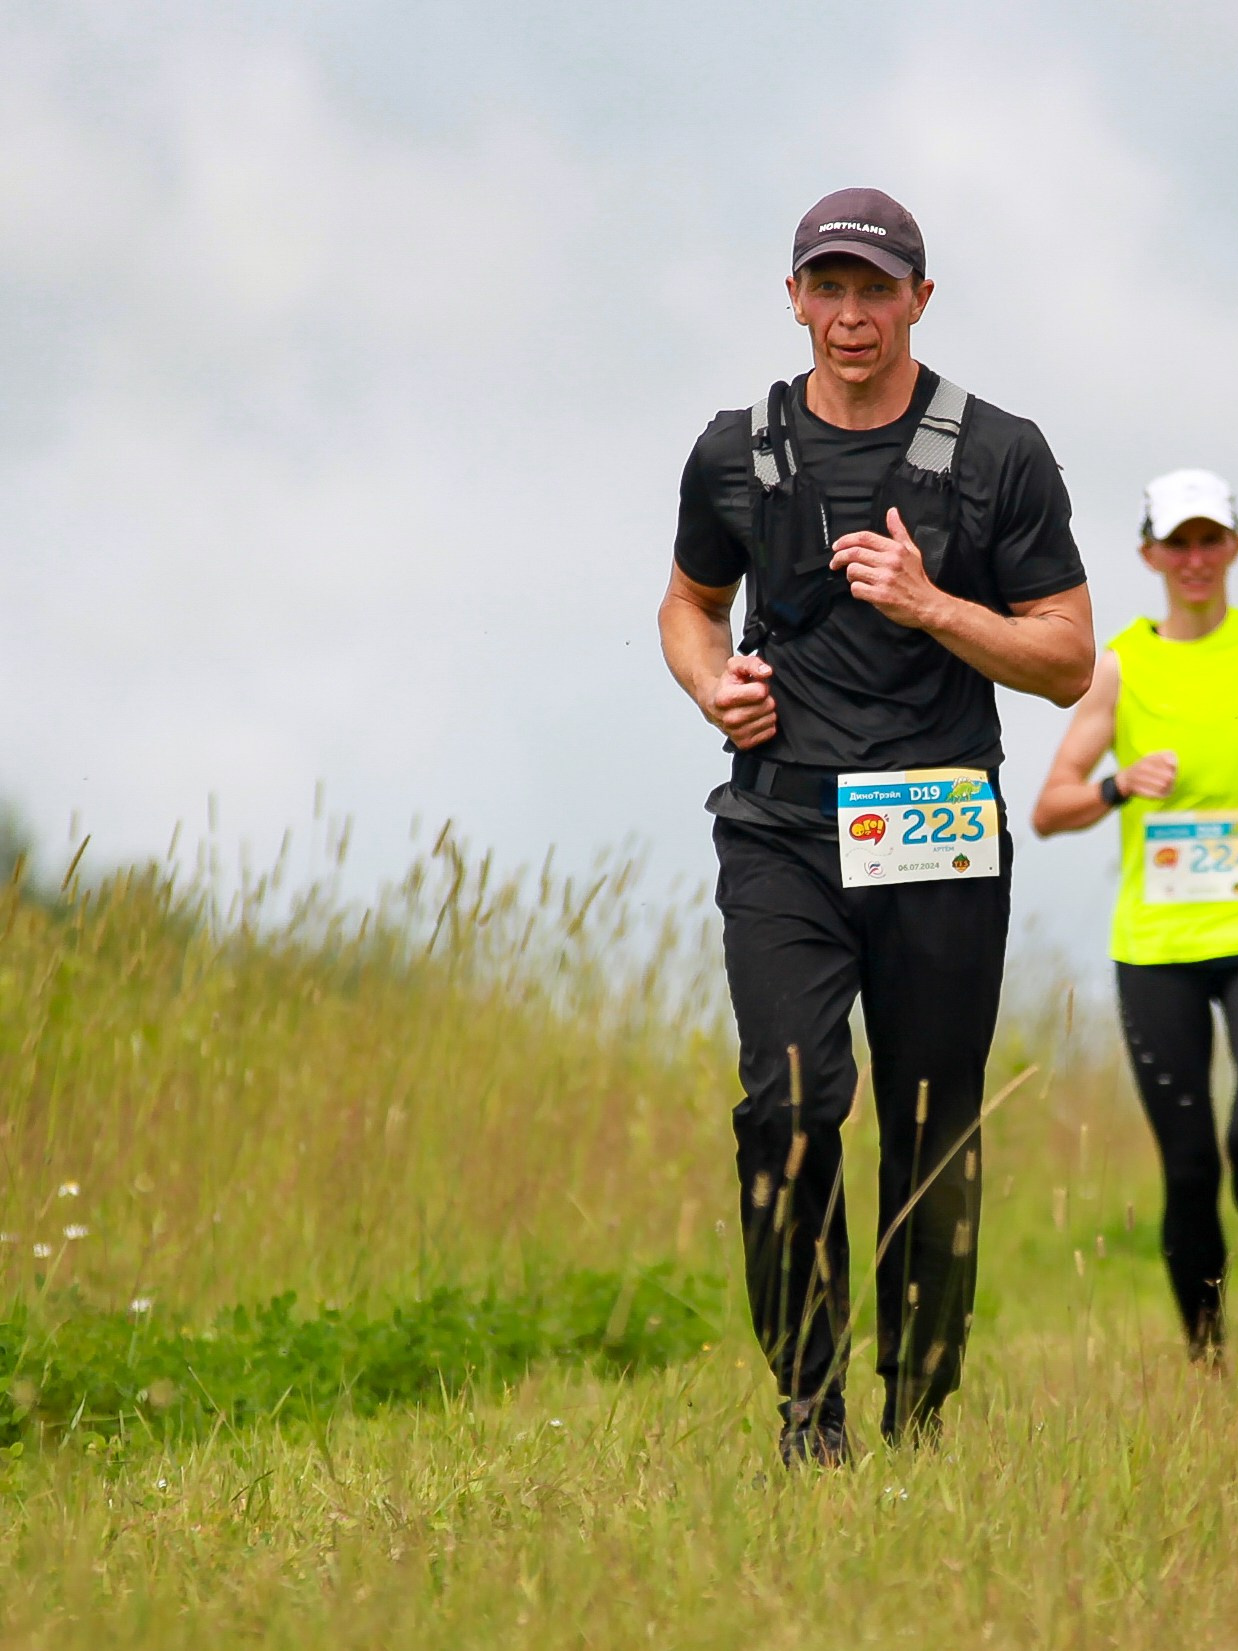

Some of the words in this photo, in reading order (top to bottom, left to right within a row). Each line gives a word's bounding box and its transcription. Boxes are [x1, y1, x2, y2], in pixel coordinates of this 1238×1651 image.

[818, 221, 887, 235] NORTHLAND
[849, 791, 902, 802] ДиноТрэйл
[909, 786, 941, 801] D19
[902, 806, 985, 844] 223
[897, 862, 940, 872] 06.07.2024
